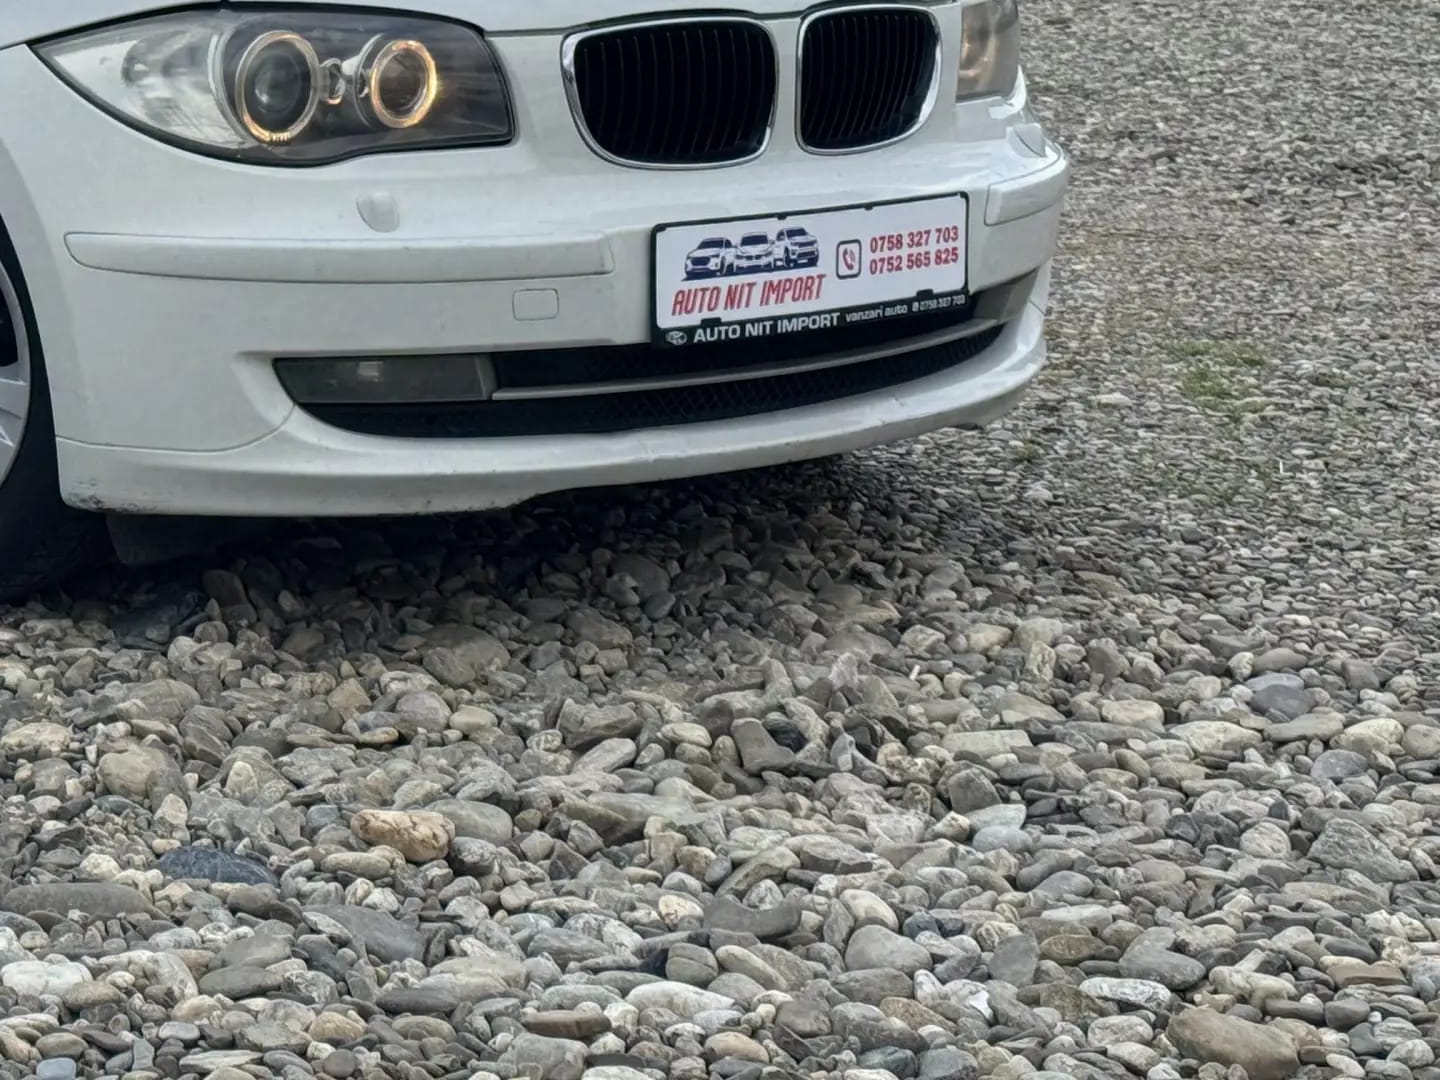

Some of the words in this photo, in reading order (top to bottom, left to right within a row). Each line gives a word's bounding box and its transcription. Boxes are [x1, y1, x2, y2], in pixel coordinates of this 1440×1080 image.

[870, 233, 903, 253] 0758
[907, 229, 931, 248] 327
[935, 225, 959, 244] 703
[870, 255, 903, 275] 0752
[907, 251, 931, 270] 565
[934, 246, 959, 265] 825
[671, 286, 721, 316] AUTO
[724, 282, 756, 310] NIT
[760, 274, 826, 307] IMPORT
[693, 324, 741, 343] AUTO
[745, 319, 775, 337] NIT
[777, 312, 840, 333] IMPORT
[885, 304, 908, 317] auto
